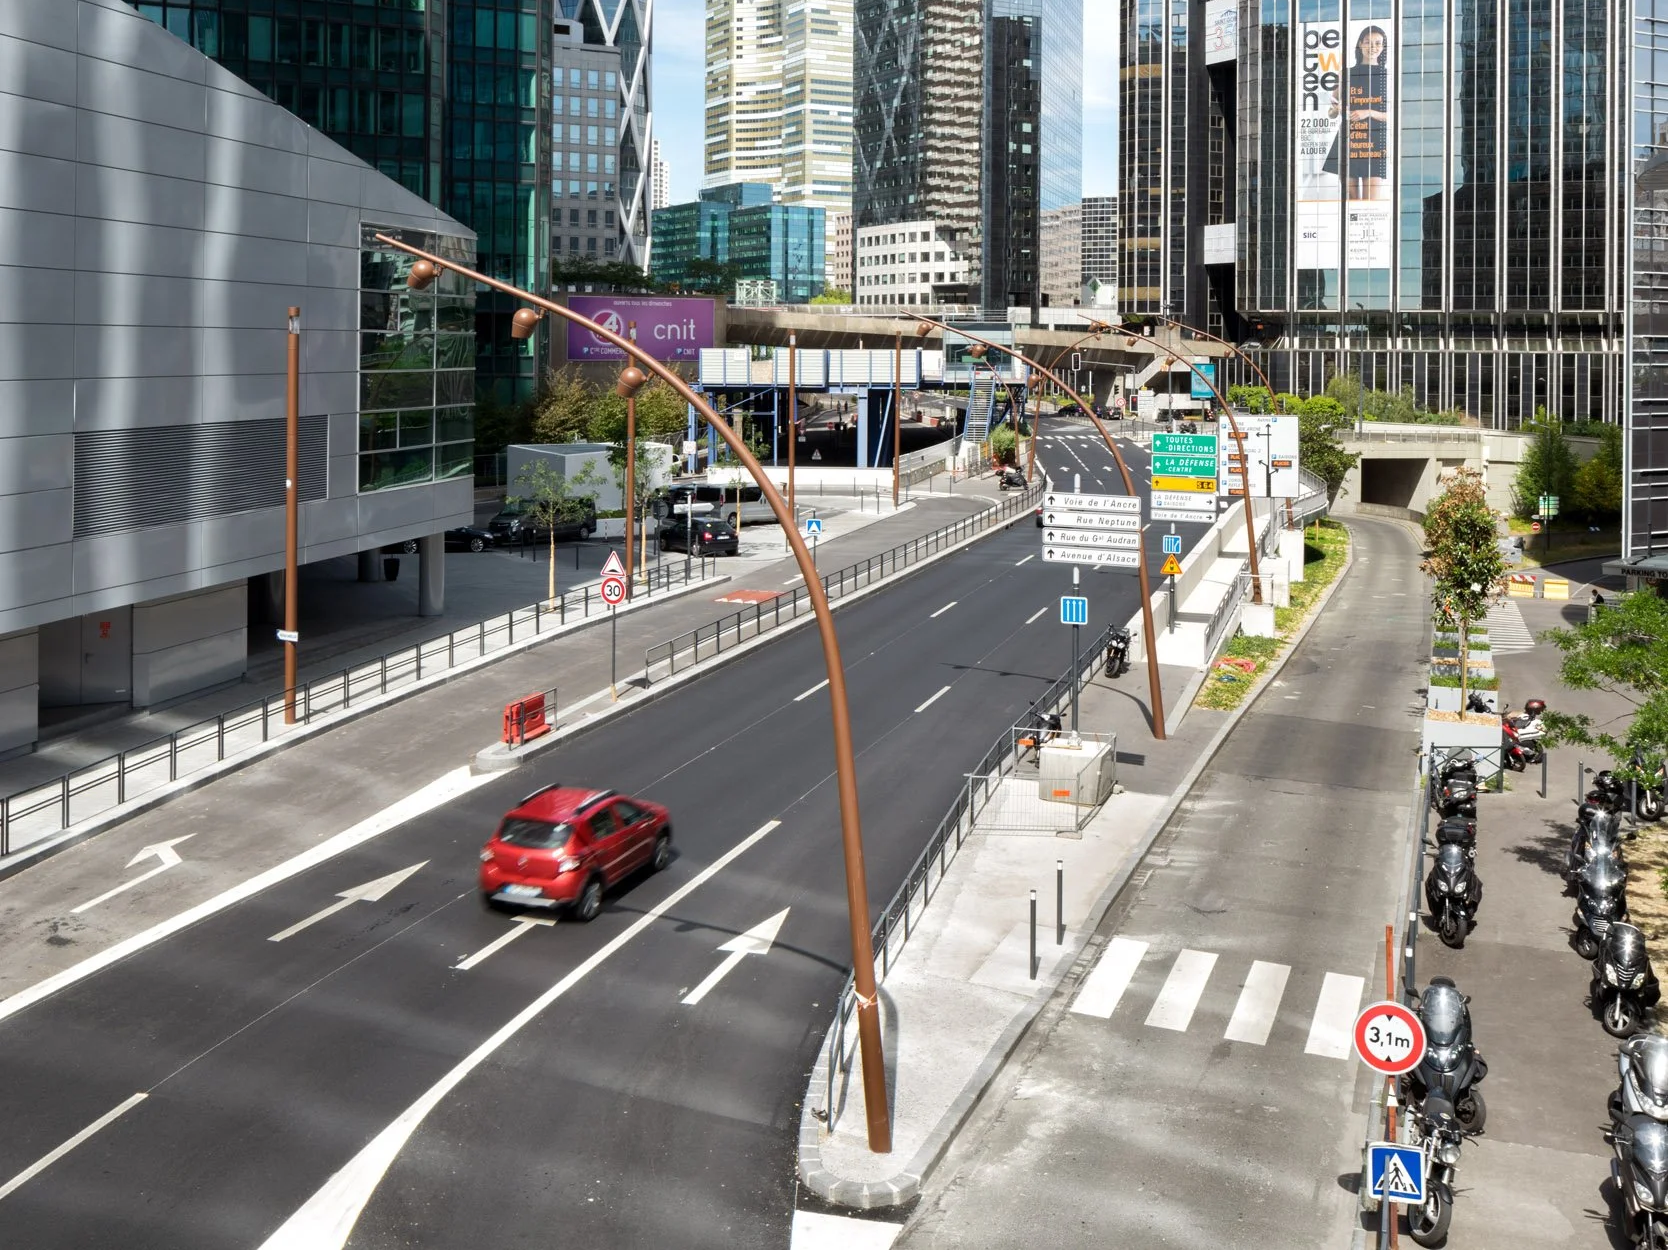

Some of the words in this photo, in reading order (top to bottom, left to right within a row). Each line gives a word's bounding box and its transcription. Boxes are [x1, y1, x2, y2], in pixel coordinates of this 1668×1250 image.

[654, 318, 696, 340] cnit
[1179, 458, 1214, 467] DÉFENSE
[1104, 500, 1136, 508] l'Ancre
[1076, 516, 1093, 524] Rue
[1098, 518, 1137, 526] Neptune
[1060, 533, 1076, 541] Rue
[1107, 536, 1136, 544] Audran
[1061, 551, 1092, 560] Avenue
[1098, 554, 1136, 563] d'Alsace
[606, 585, 620, 596] 30
